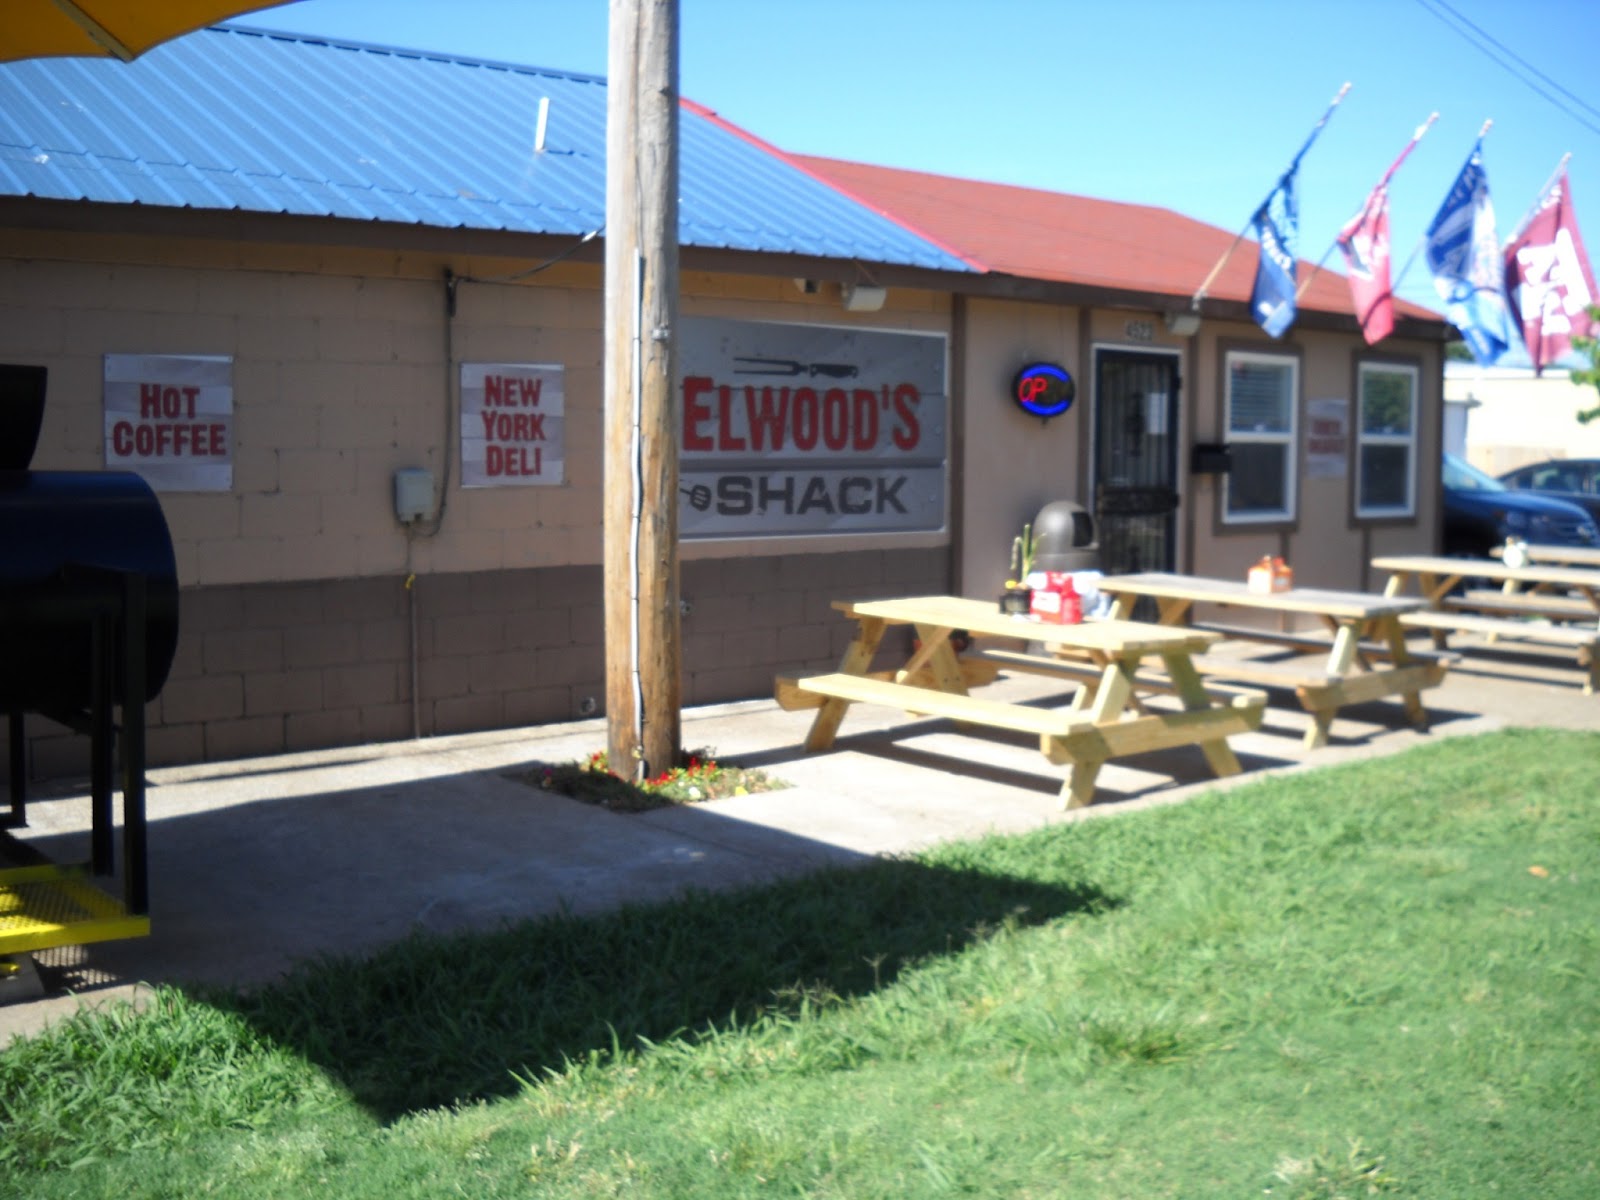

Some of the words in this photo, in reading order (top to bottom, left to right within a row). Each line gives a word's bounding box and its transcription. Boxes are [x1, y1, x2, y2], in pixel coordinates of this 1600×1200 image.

[140, 383, 200, 419] HOT
[485, 375, 542, 407] NEW
[482, 411, 545, 441] YORK
[683, 376, 921, 451] ELWOOD'S
[113, 421, 226, 456] COFFEE
[486, 447, 542, 476] DELI
[717, 476, 909, 515] SHACK
